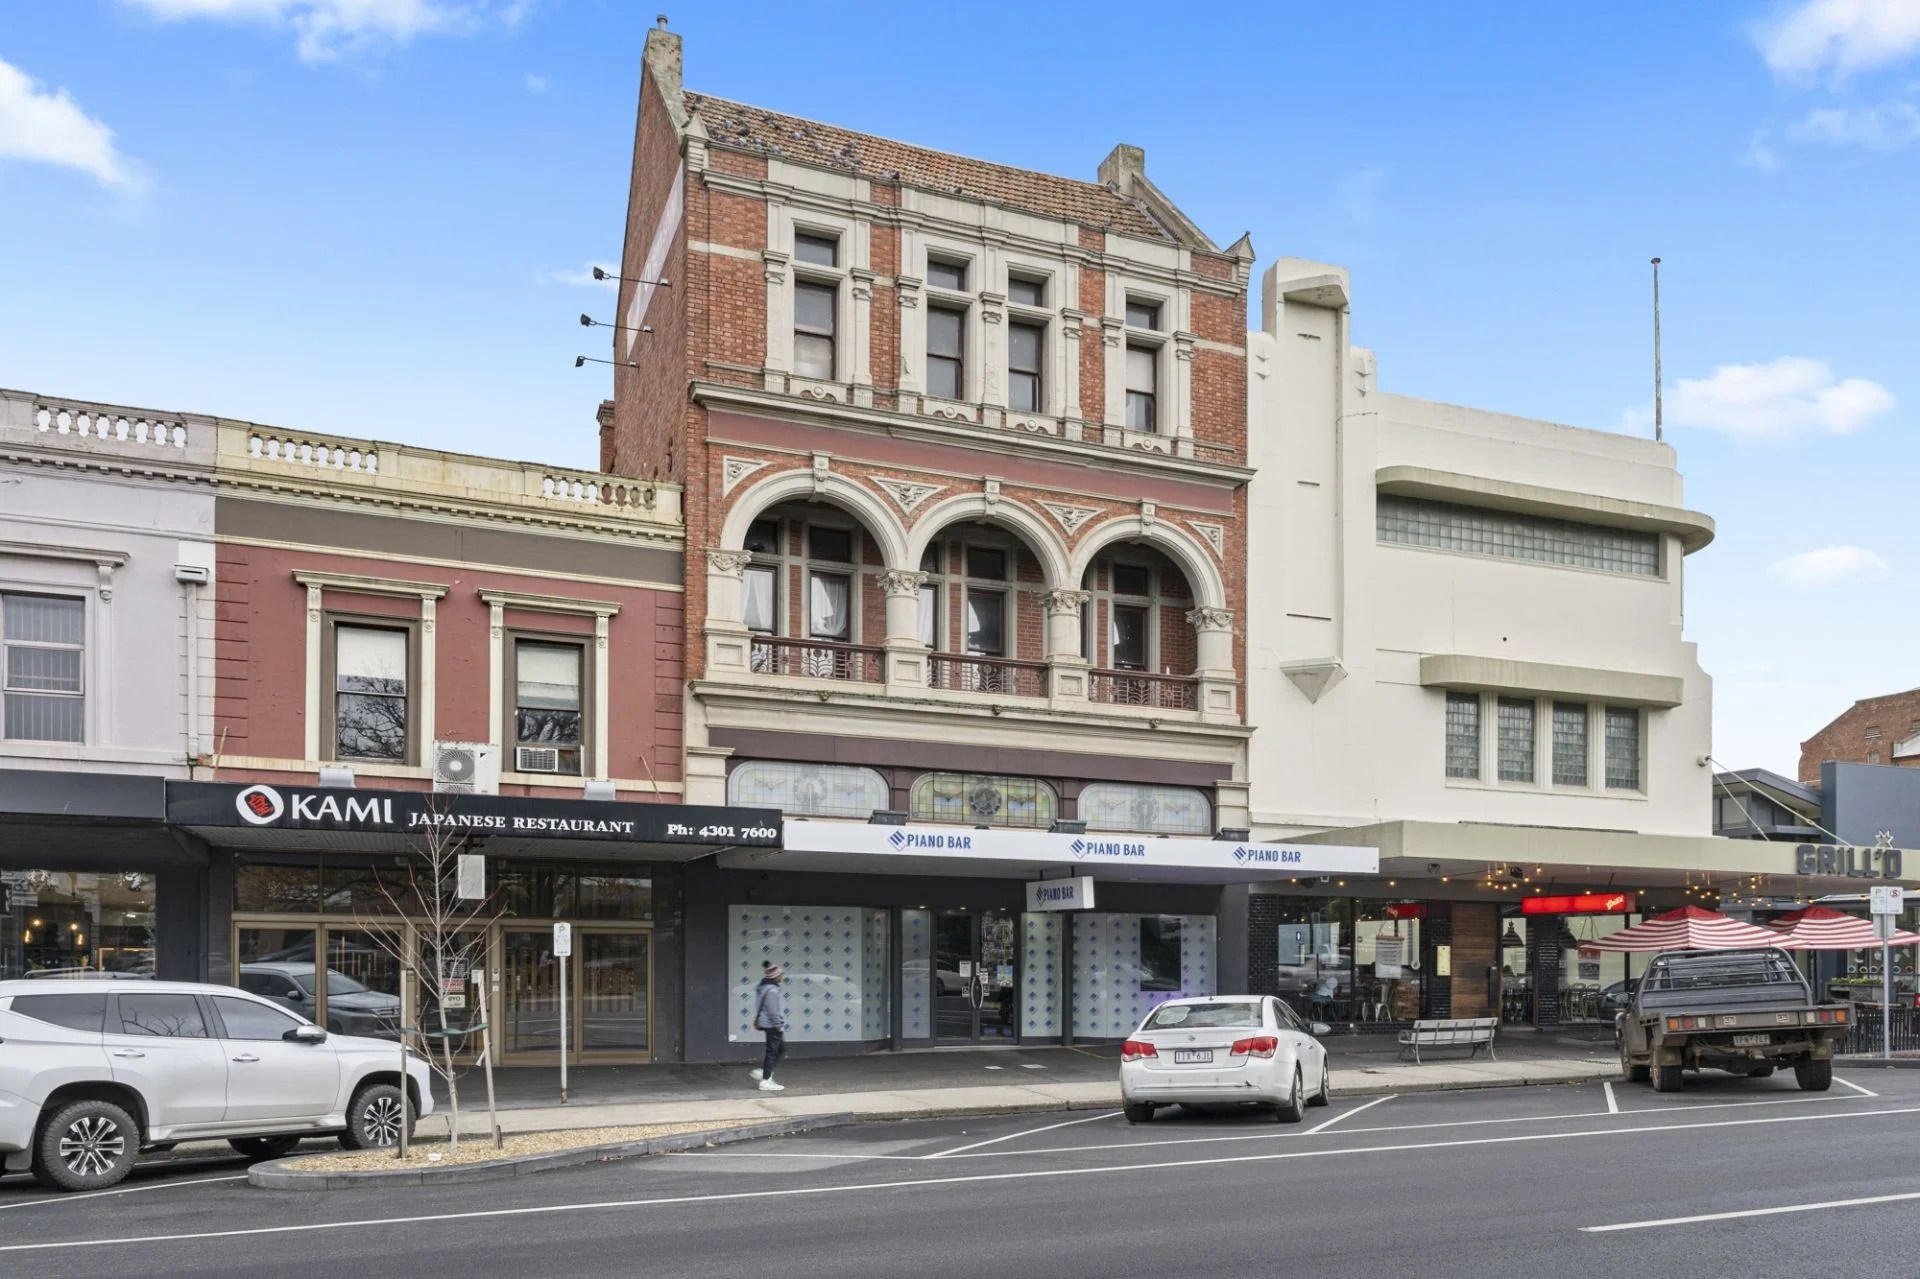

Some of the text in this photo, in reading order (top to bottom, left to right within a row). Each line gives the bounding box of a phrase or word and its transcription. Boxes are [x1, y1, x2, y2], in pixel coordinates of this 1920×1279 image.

[291, 794, 394, 824] KAMI
[408, 812, 634, 833] JAPANESE RESTAURANT
[667, 823, 777, 839] Ph: 4301 7600
[907, 833, 971, 849] PIANO BAR
[1087, 842, 1145, 857] PIANO BAR
[1248, 849, 1301, 863] PIANO BAR
[1043, 885, 1074, 901] PIANO BAR
